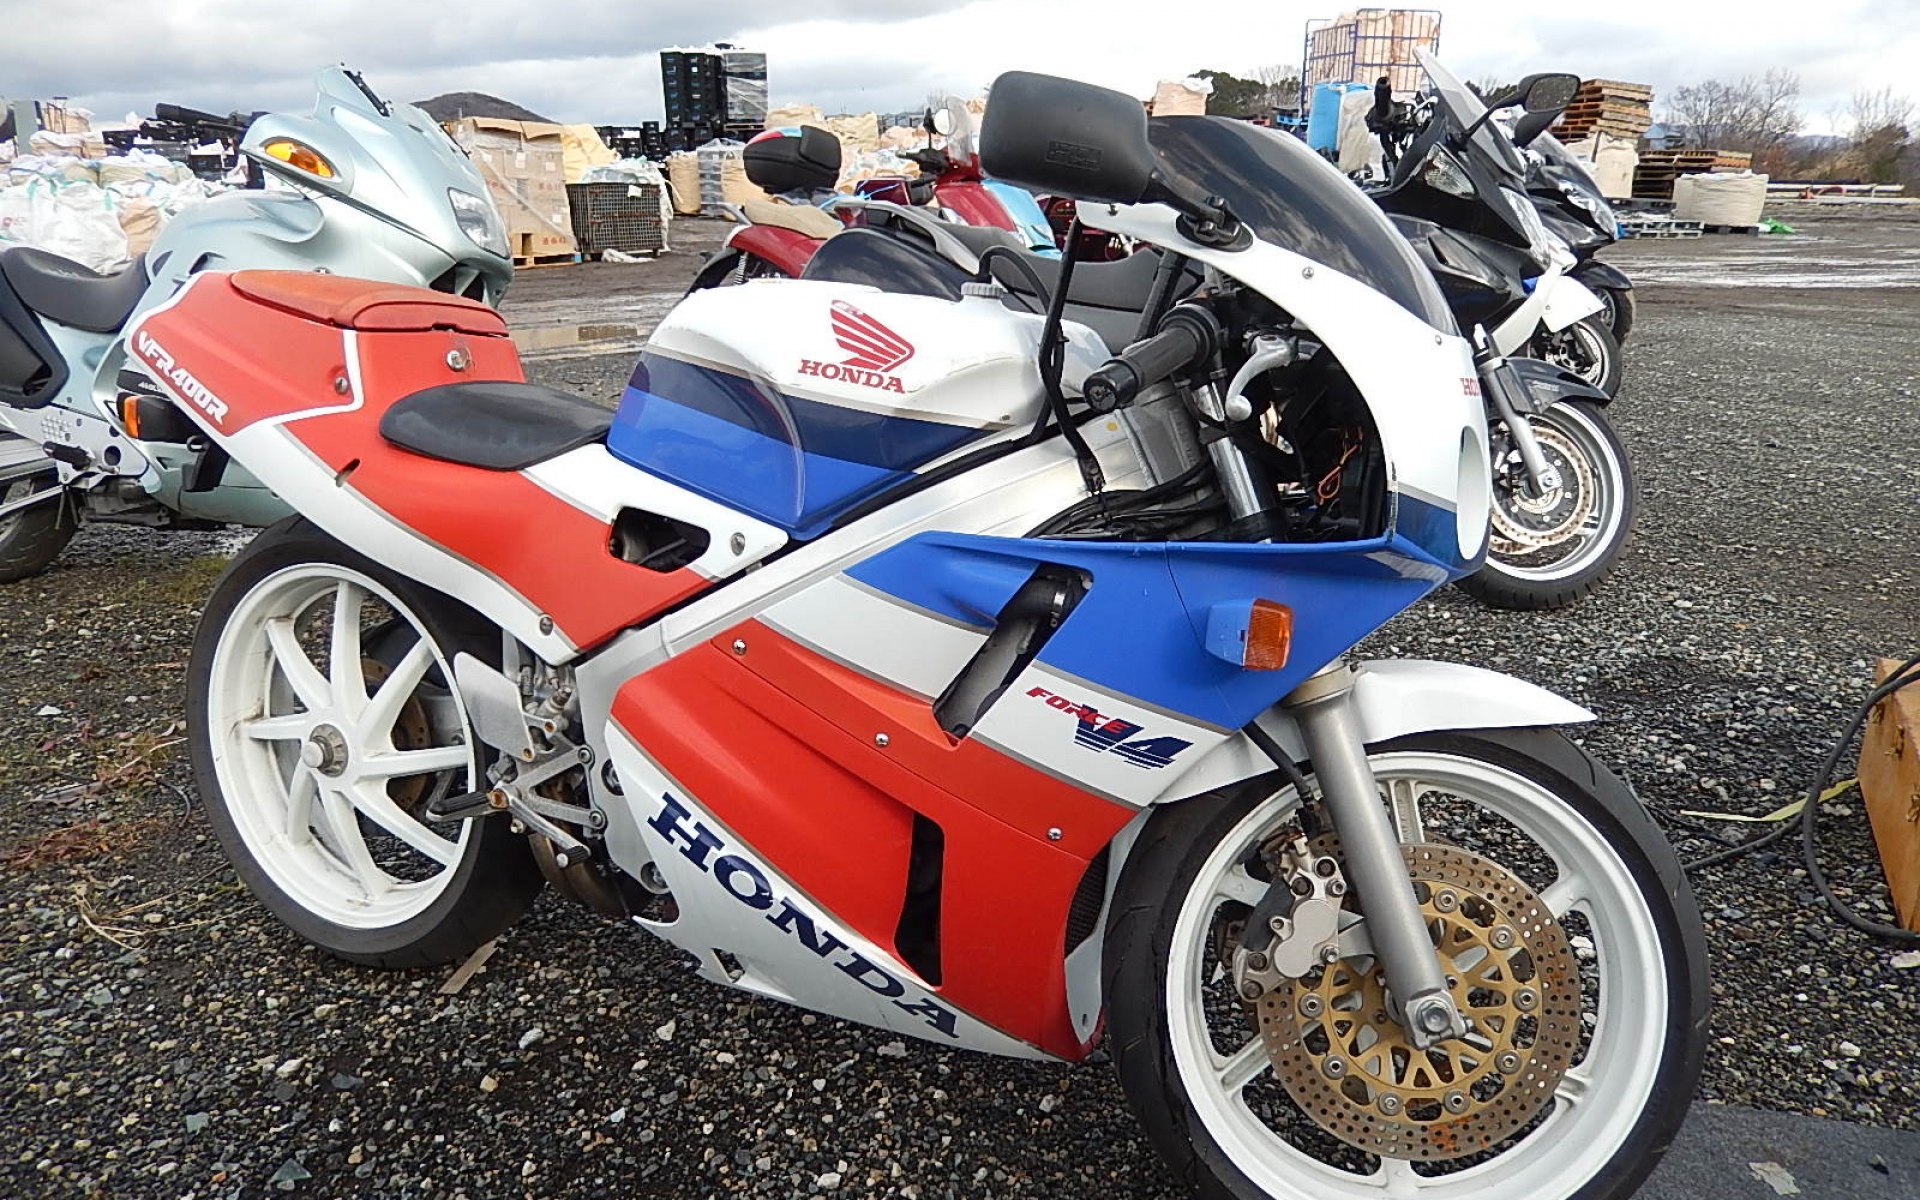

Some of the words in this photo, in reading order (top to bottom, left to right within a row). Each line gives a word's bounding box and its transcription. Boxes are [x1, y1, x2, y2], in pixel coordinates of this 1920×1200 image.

[138, 330, 228, 425] VFR400R
[798, 359, 906, 394] HONDA
[1026, 686, 1131, 734] FORCE
[1074, 704, 1194, 769] V4
[647, 792, 960, 1038] HONDA
